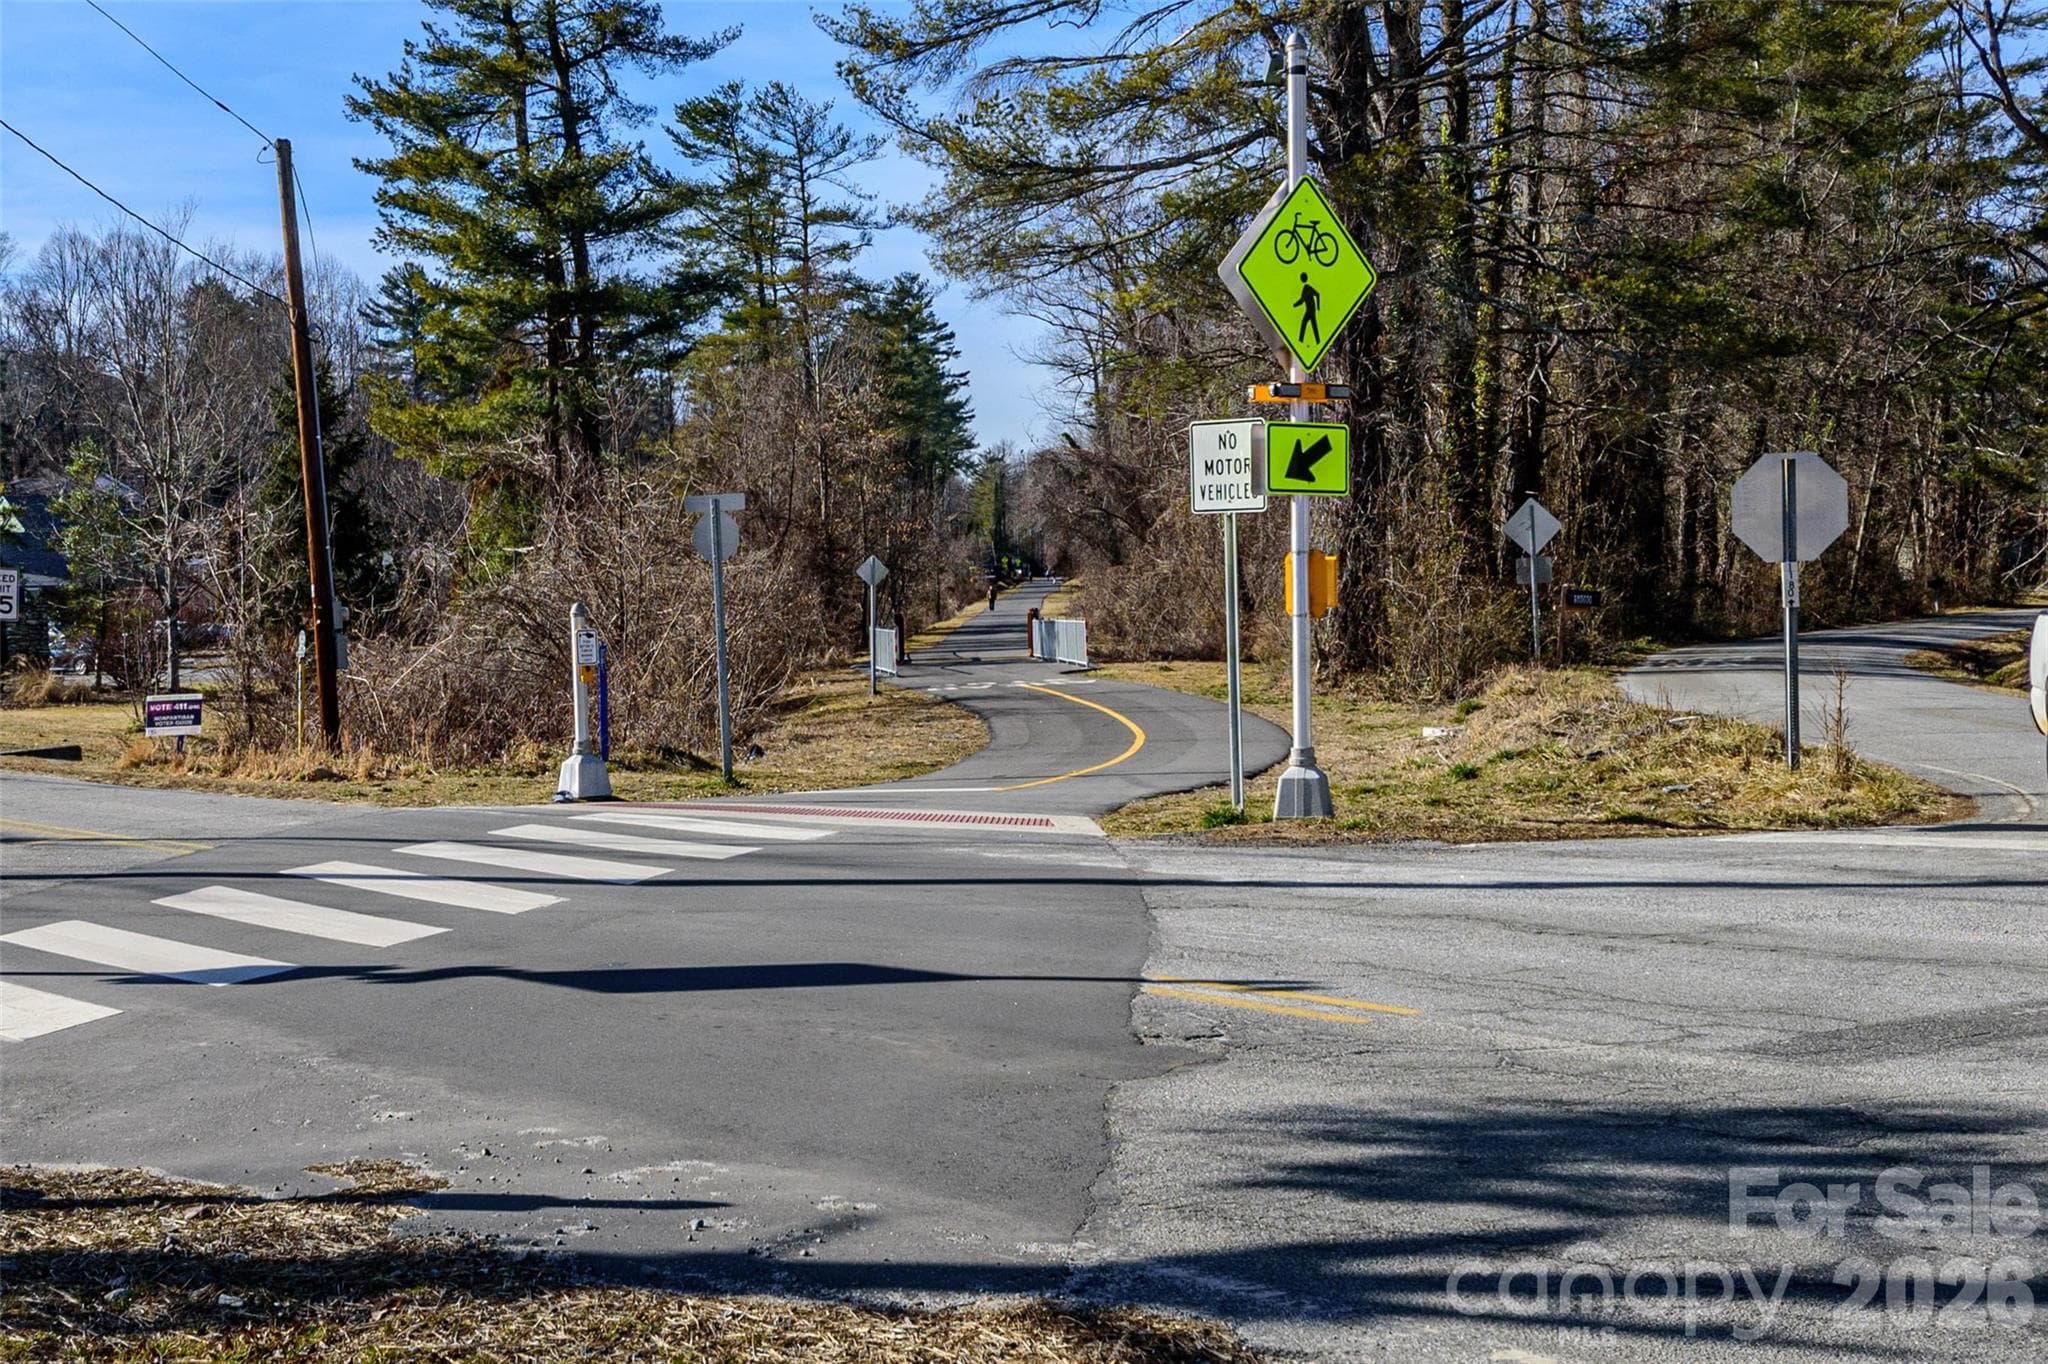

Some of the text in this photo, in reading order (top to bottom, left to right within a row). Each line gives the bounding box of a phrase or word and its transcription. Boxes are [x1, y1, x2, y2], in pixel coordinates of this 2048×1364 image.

[1218, 432, 1237, 450] NO
[1204, 458, 1251, 476] MOTOR
[1200, 483, 1258, 501] VEHICLE
